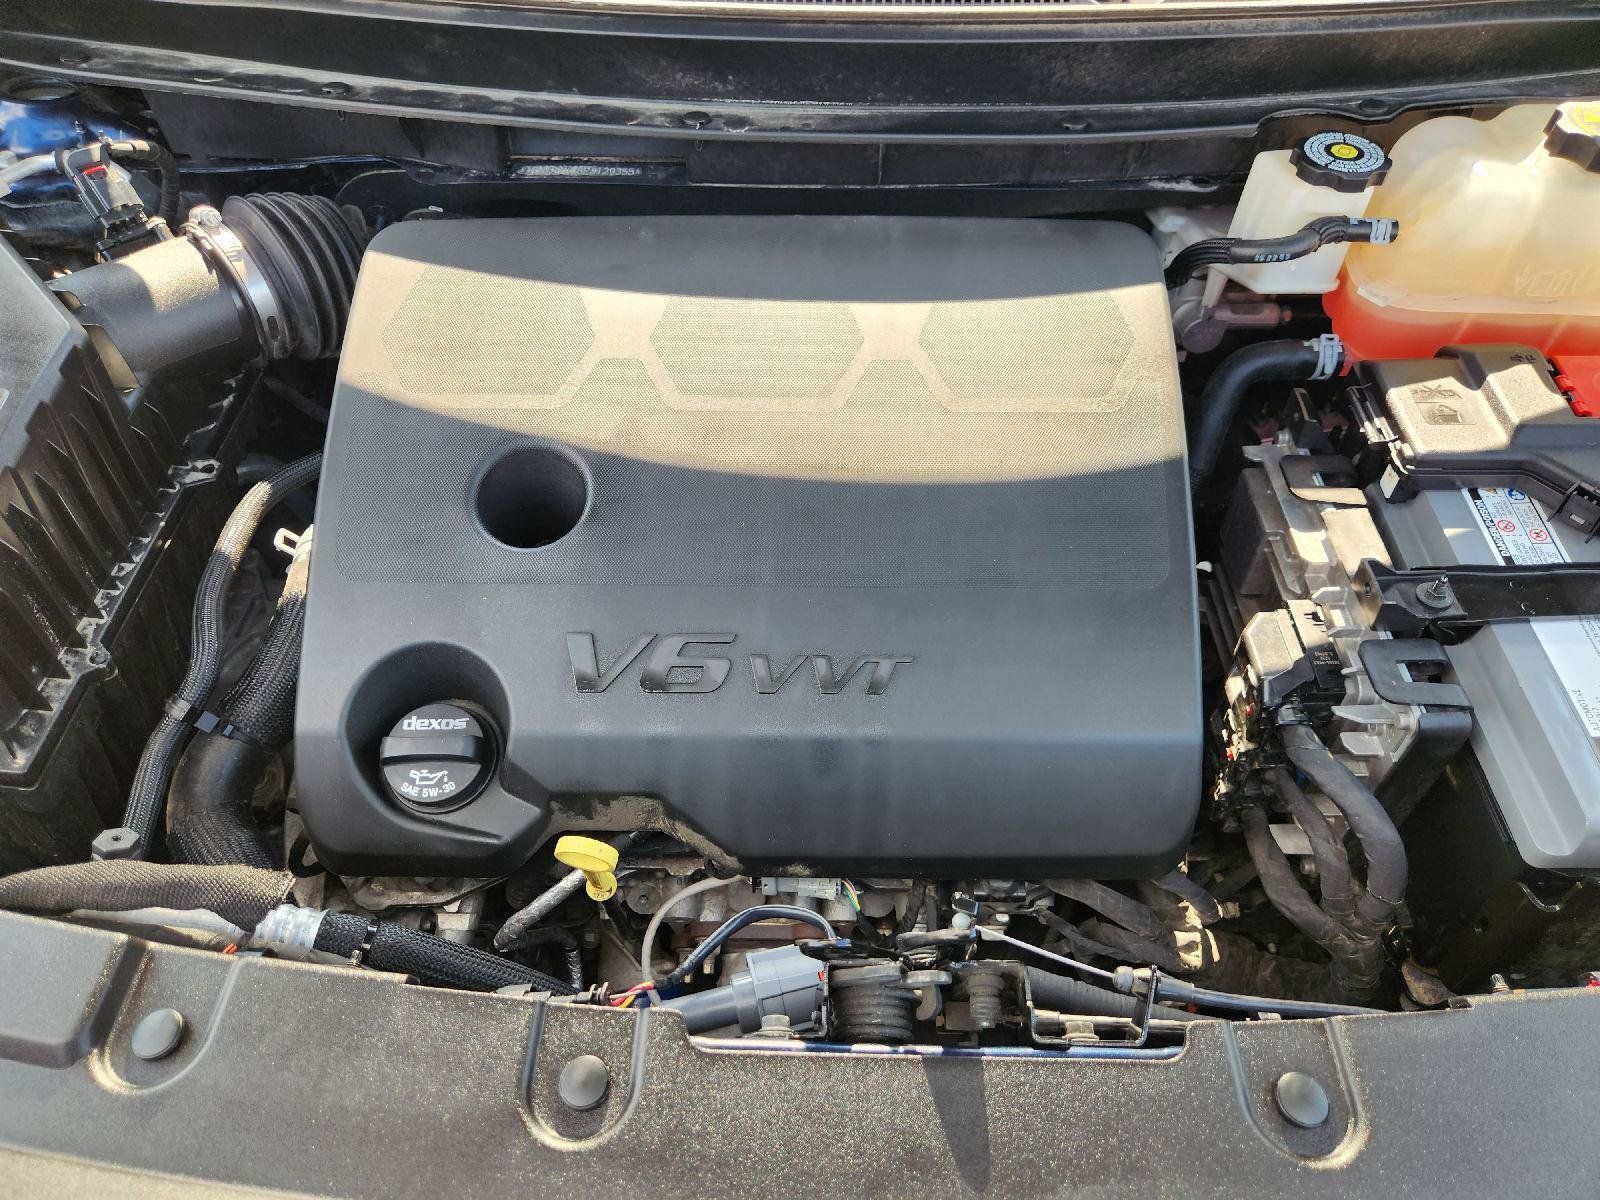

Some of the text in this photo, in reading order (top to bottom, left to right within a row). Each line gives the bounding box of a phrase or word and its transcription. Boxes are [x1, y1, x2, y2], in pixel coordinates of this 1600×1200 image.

[566, 632, 915, 695] V6 VVT
[403, 716, 469, 731] dexos
[401, 781, 456, 797] SAE 5W-30
